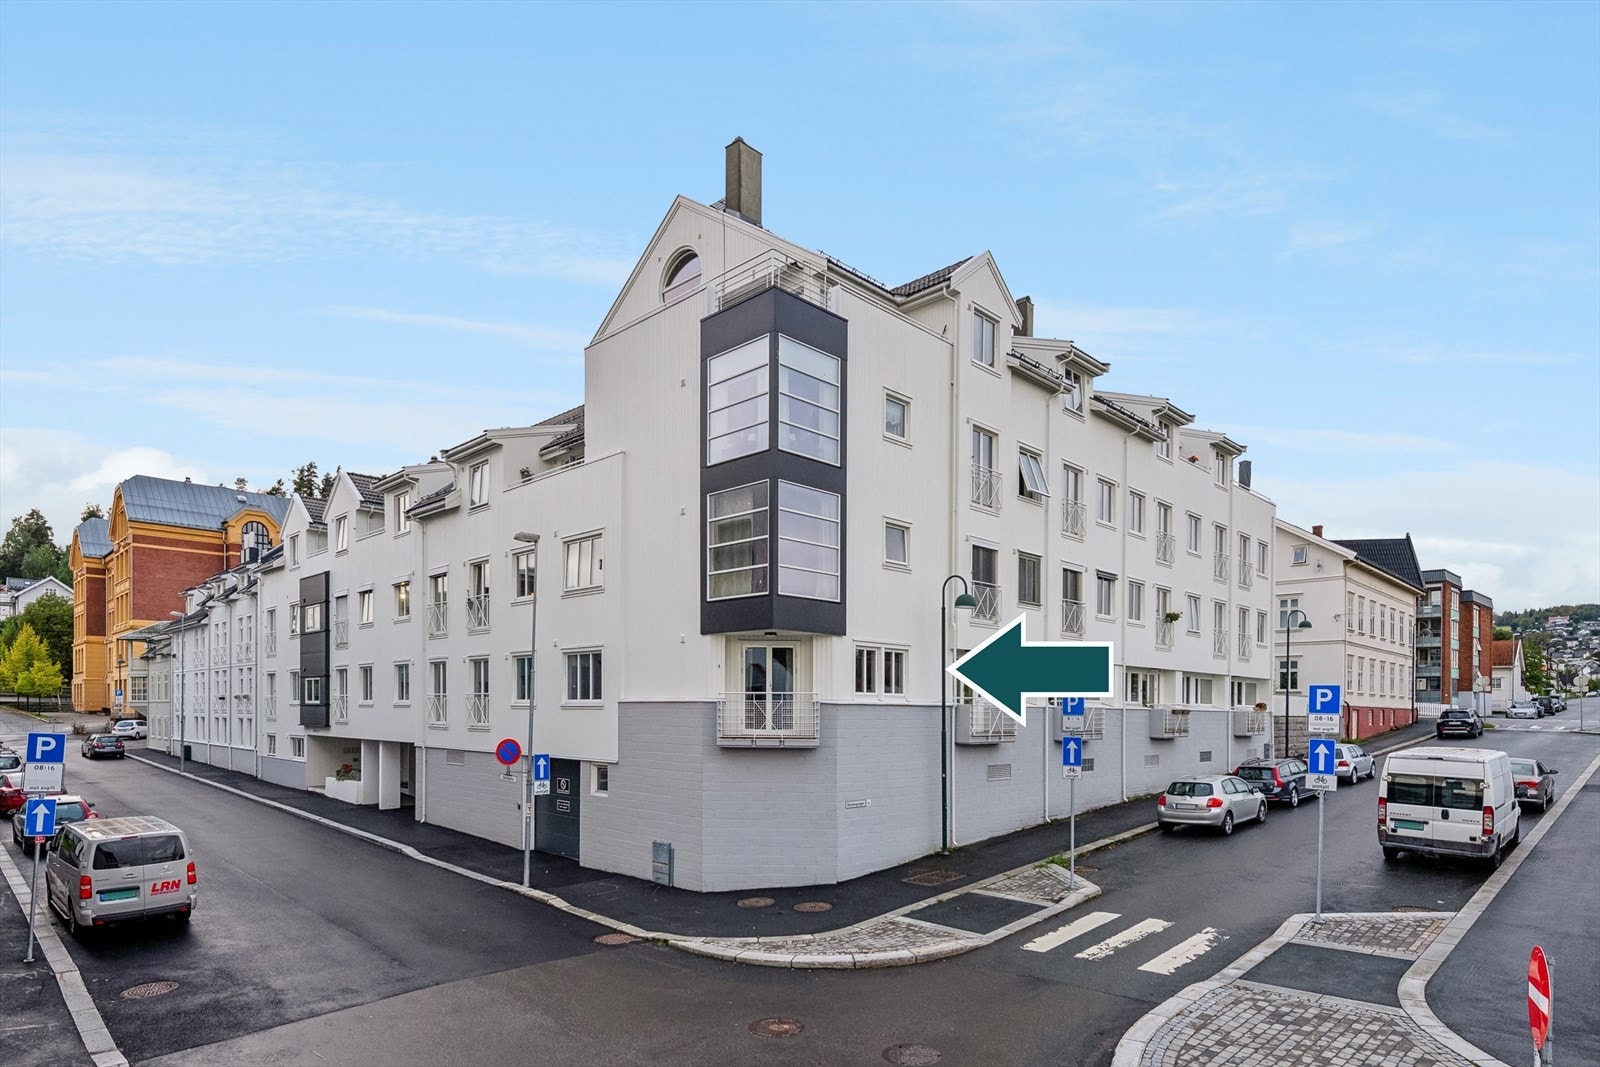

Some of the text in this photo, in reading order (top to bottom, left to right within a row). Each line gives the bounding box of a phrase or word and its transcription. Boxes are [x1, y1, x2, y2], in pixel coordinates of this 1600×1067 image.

[1067, 697, 1079, 713] P
[1316, 688, 1333, 710] P
[35, 736, 56, 760] P
[151, 879, 181, 893] LRN
